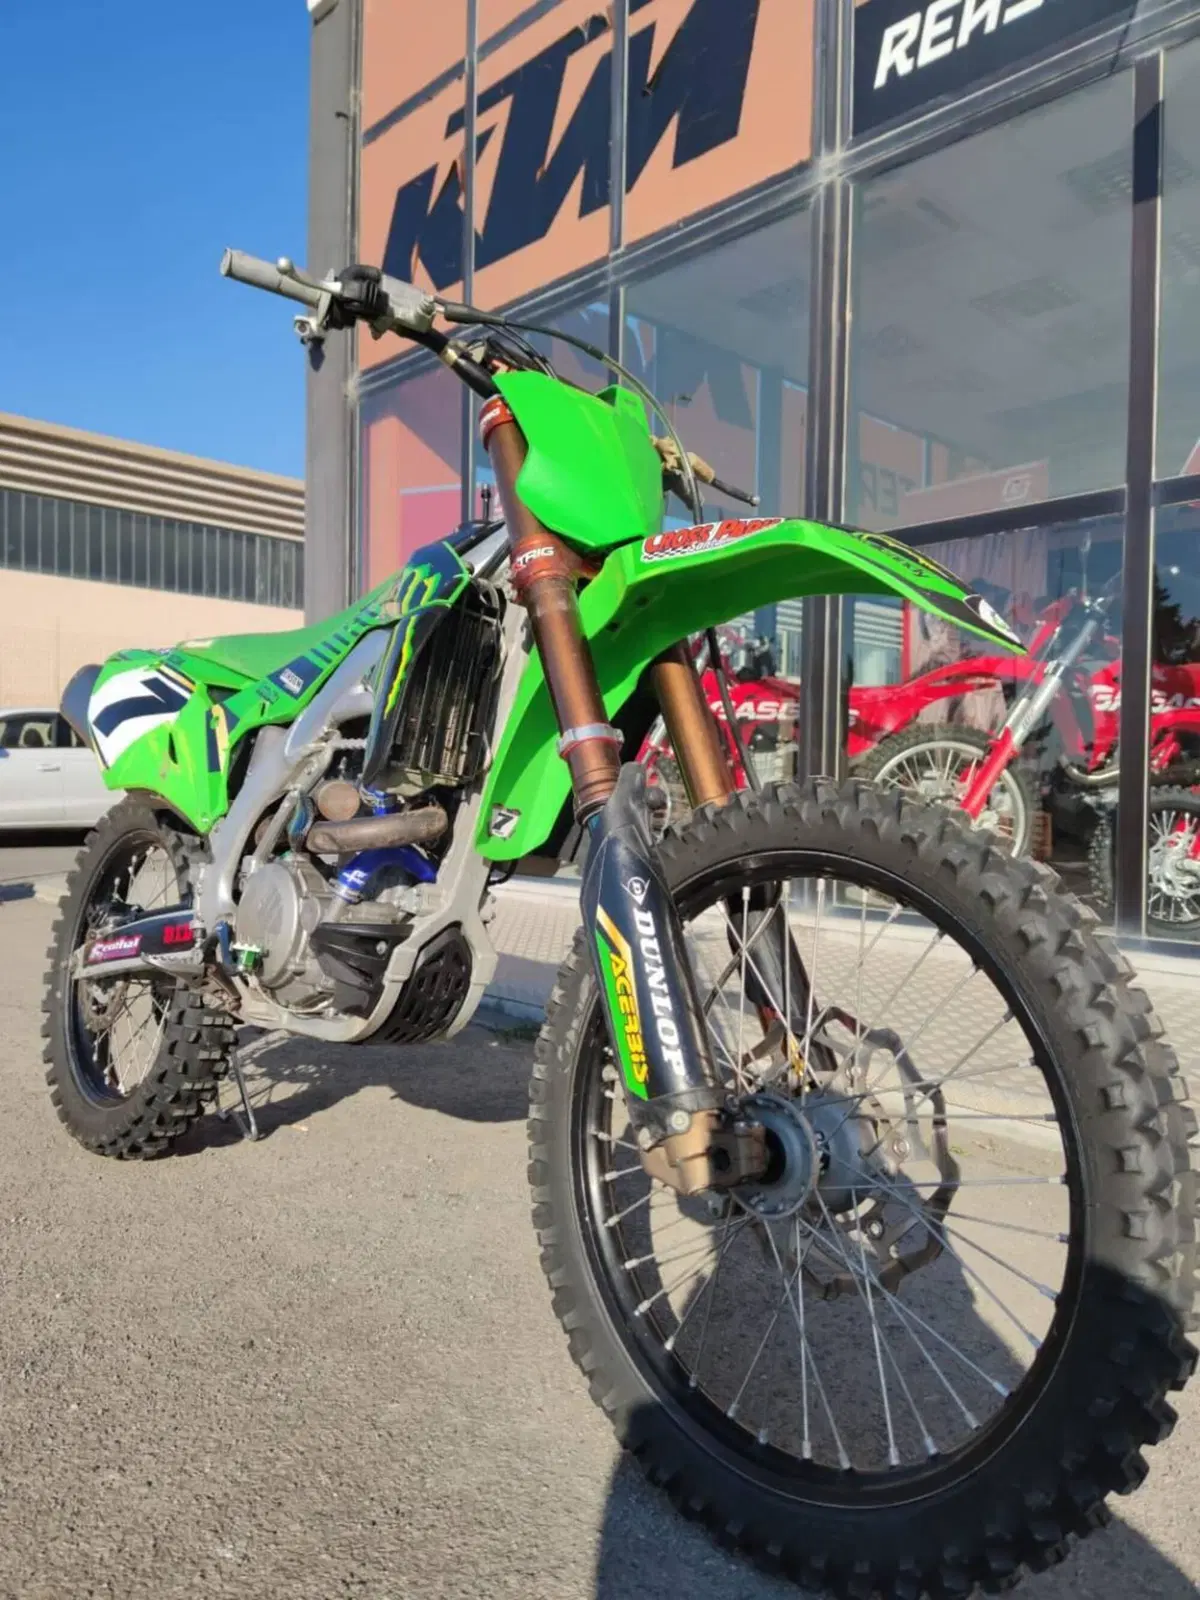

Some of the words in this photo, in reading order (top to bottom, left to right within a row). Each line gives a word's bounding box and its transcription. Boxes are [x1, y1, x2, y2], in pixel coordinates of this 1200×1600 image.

[382, 0, 760, 290] KTM
[644, 524, 713, 555] CROSS
[492, 812, 514, 831] 7
[609, 952, 649, 1084] ACERBIS
[633, 908, 687, 1077] DUNLOP
